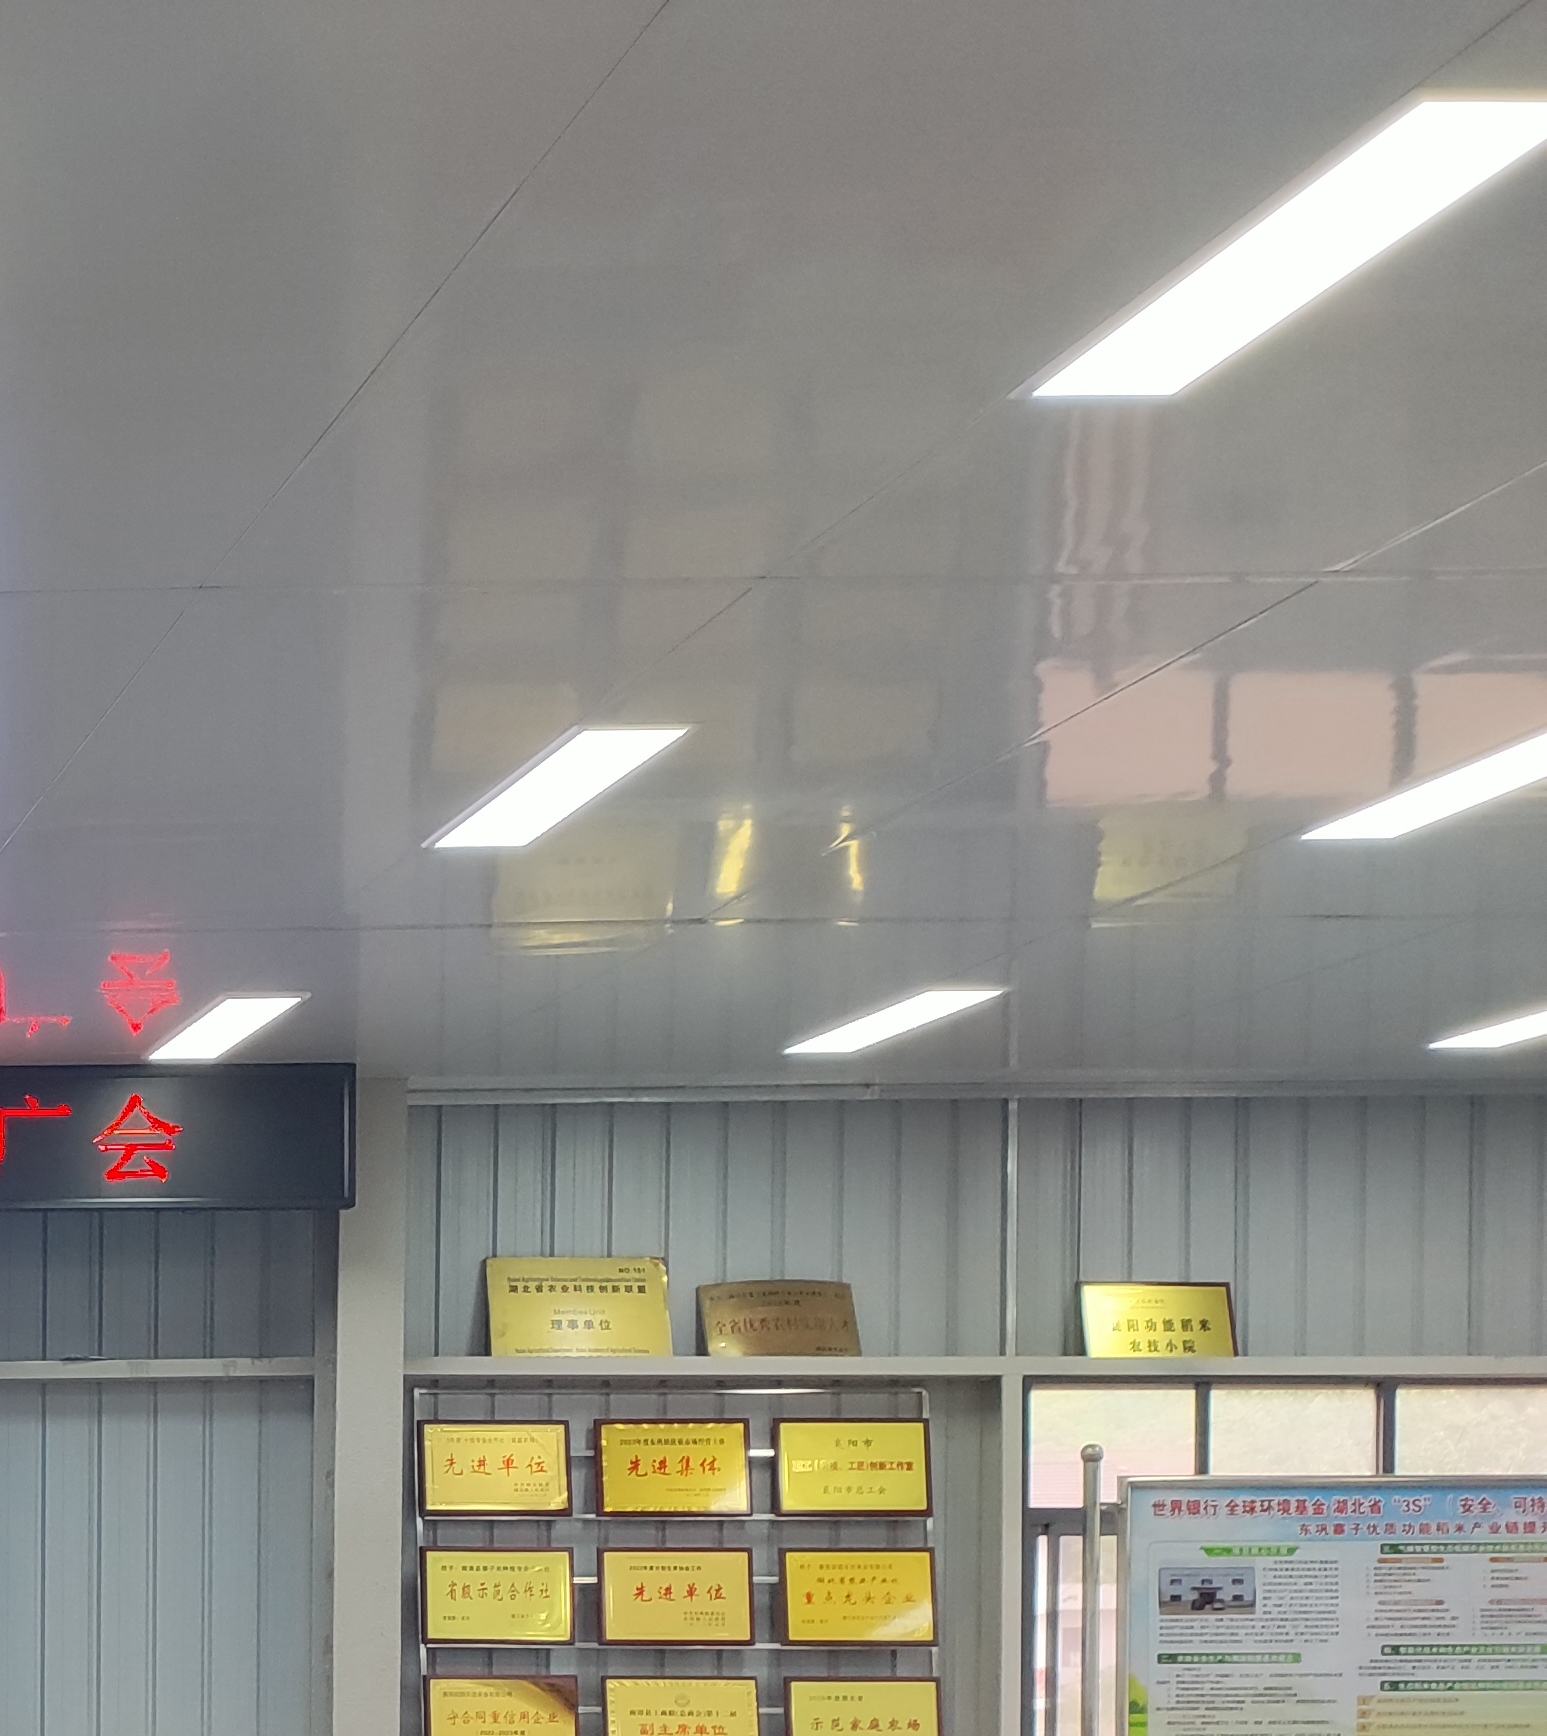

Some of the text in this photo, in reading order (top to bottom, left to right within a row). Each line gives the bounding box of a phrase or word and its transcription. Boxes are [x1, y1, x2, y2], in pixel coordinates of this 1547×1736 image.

[508, 1284, 647, 1294] 湖北省农业科技创新联盟
[550, 1318, 612, 1331] 理事单位
[443, 1453, 549, 1477] 先进单位
[626, 1454, 722, 1478] 先进集体
[1151, 1498, 1219, 1517] 世界银行
[1224, 1498, 1327, 1517] 全球环境基金
[446, 1580, 551, 1602] 省级示范合作社
[633, 1581, 727, 1602] 先进单位
[446, 1709, 560, 1726] 守合同重信用企业
[810, 1717, 921, 1732] 示范家庭农场
[639, 1723, 728, 1736] 副主席单位
